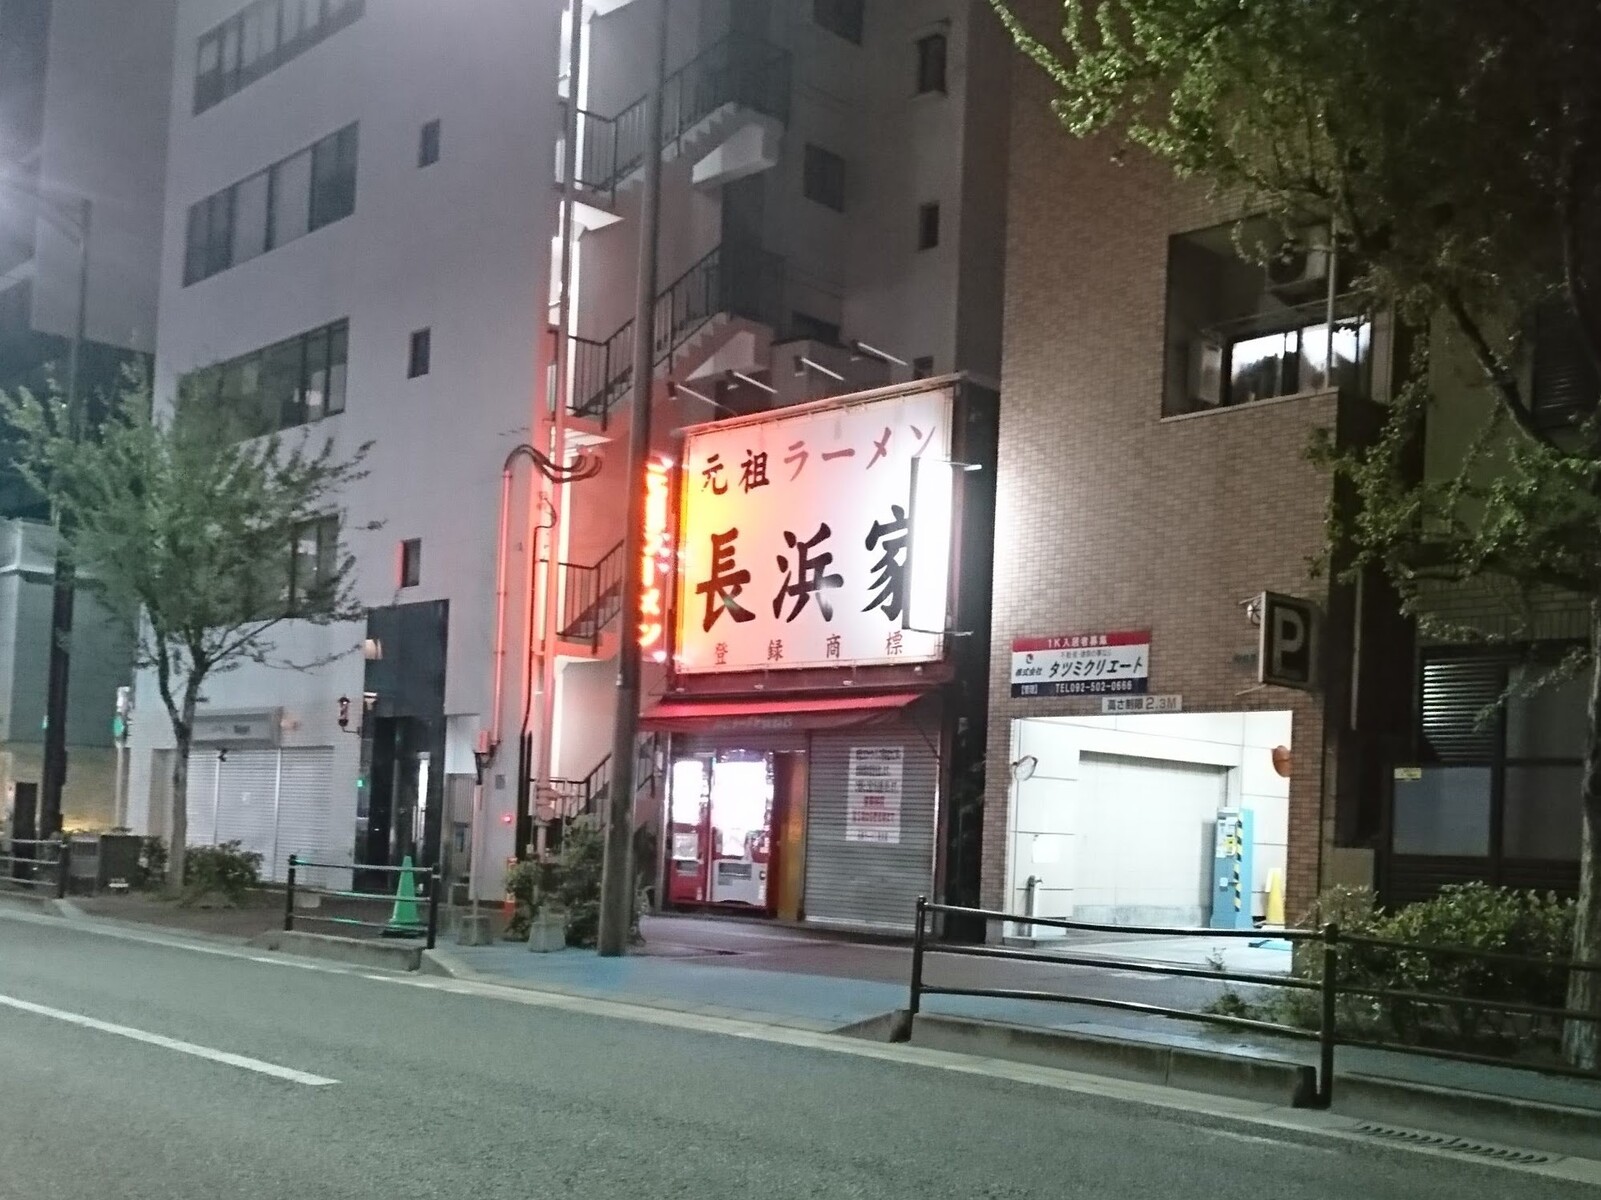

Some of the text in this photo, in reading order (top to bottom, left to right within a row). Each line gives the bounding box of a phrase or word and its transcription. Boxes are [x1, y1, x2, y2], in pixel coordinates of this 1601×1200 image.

[701, 426, 937, 496] 元祖ラーメン
[695, 504, 910, 633] 長浜家
[714, 630, 904, 666] 登録商標
[1049, 656, 1143, 678] タツミクリエート
[1272, 606, 1304, 674] P
